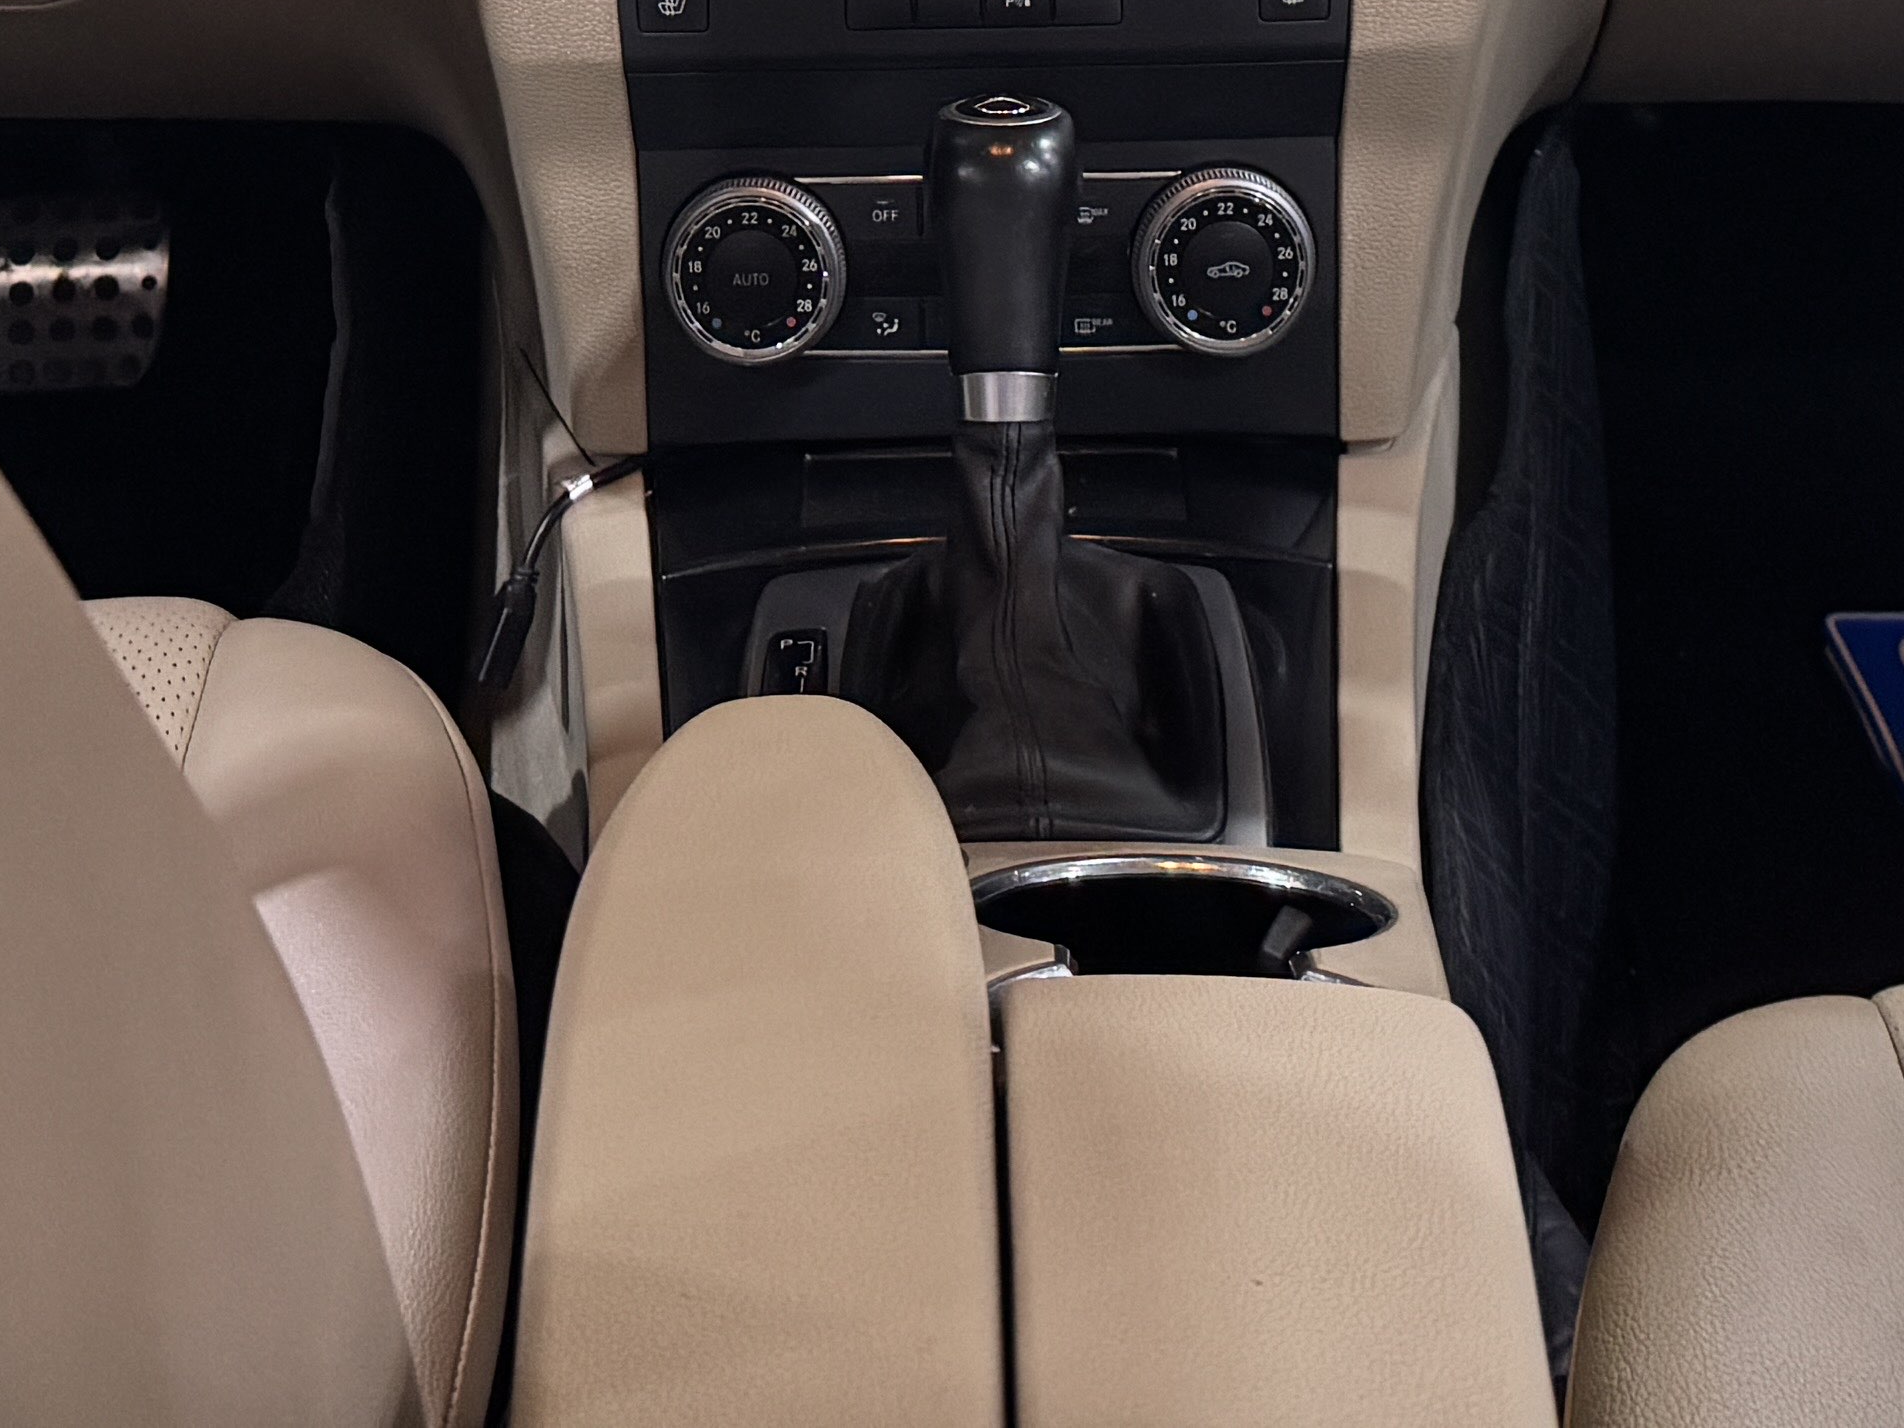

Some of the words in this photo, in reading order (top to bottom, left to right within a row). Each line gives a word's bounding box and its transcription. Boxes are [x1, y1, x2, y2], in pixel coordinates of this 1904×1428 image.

[872, 209, 899, 222] OFF
[1217, 202, 1234, 215] 22
[741, 212, 758, 225] 22
[1180, 218, 1196, 232] 20
[1257, 213, 1274, 227] 24
[704, 225, 721, 239] 20
[782, 224, 797, 238] 24
[1163, 253, 1178, 267] 18
[1277, 246, 1294, 260] 26
[688, 259, 702, 273] 18
[801, 259, 818, 272] 26
[732, 272, 770, 286] AUTO
[1172, 294, 1186, 307] 16
[1272, 287, 1288, 301] 28
[696, 301, 710, 315] 16
[796, 299, 813, 312] 28
[1219, 320, 1237, 334] °C
[744, 330, 761, 343] °C
[780, 638, 793, 650] P
